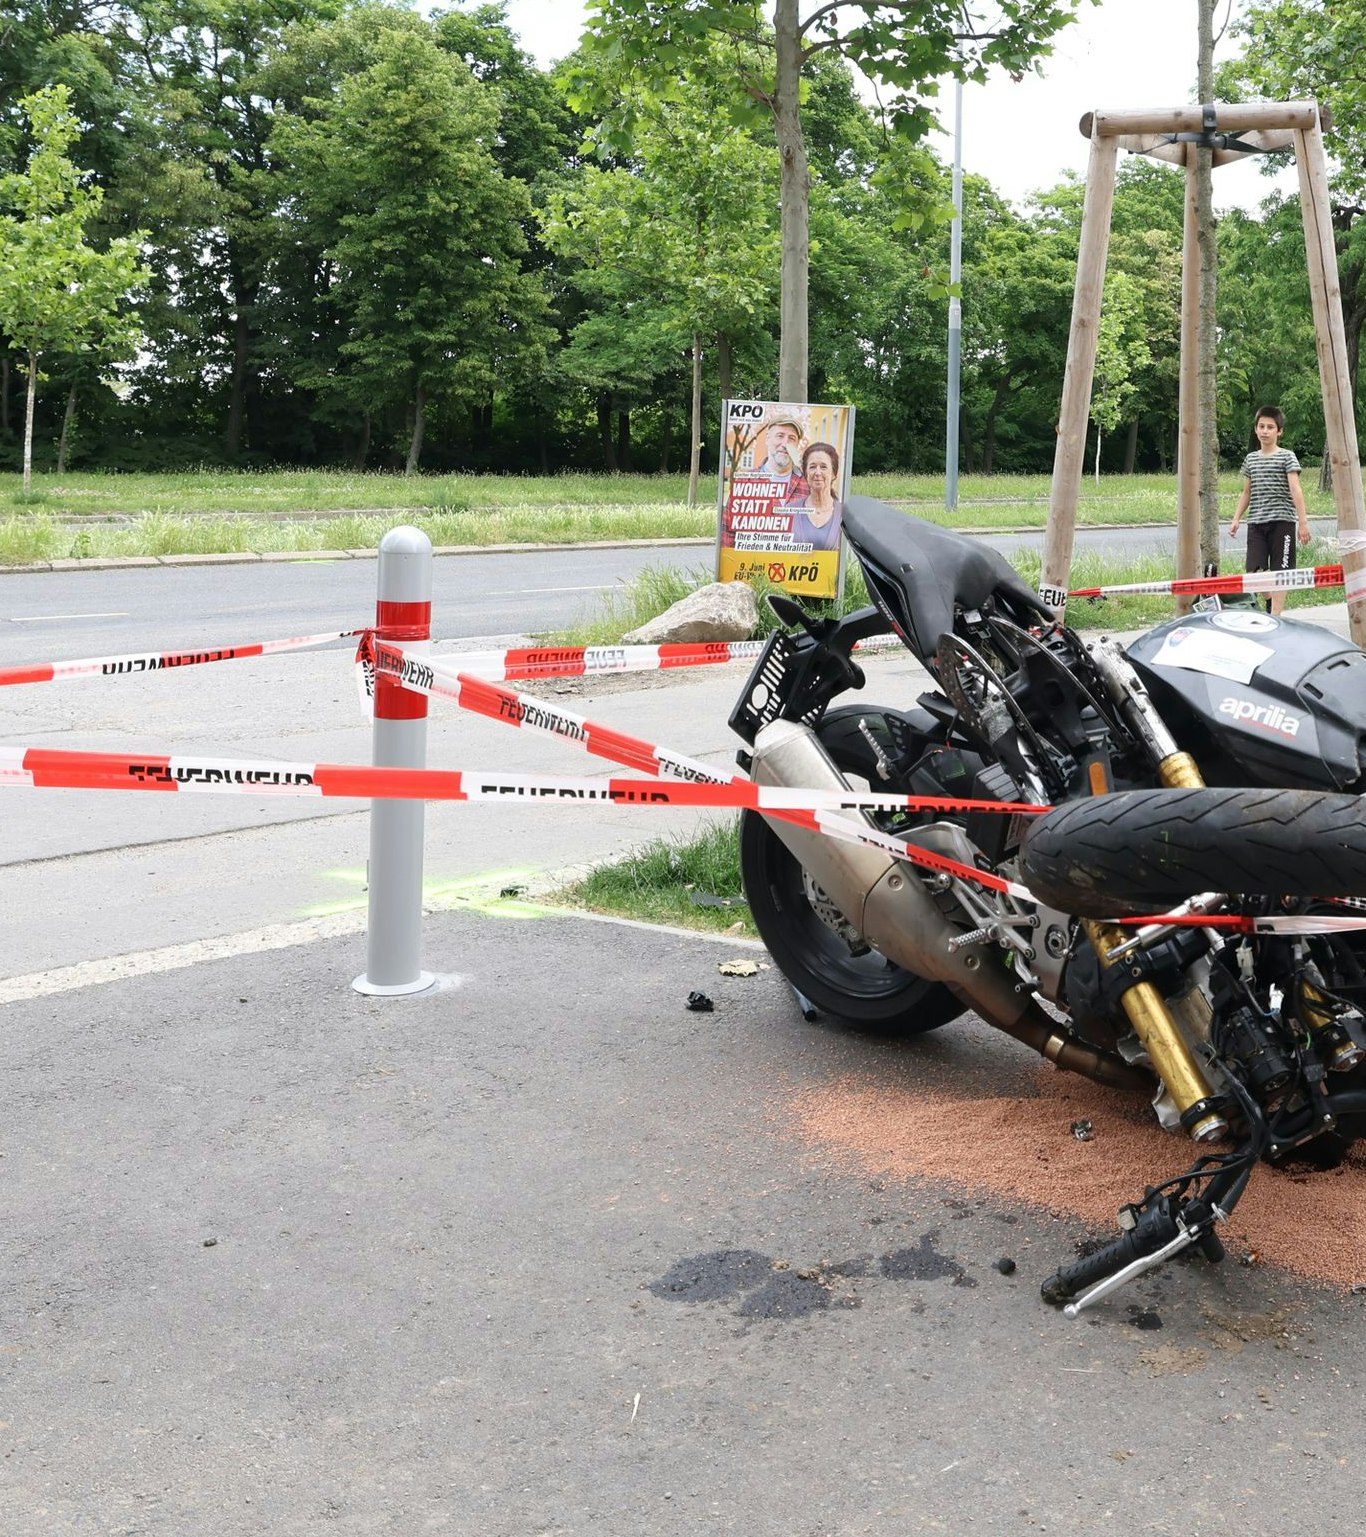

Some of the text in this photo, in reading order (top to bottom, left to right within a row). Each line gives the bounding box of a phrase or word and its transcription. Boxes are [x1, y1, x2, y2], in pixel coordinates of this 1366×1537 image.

[733, 483, 786, 498] WOHNEN
[731, 499, 770, 514] STATT
[731, 515, 791, 531] KANONEN
[737, 532, 792, 542] Ihre Stimme für
[736, 542, 812, 552] Frieden & Neutralität
[739, 562, 766, 572] 9. Juni
[788, 562, 819, 582] KPÖ
[1219, 696, 1300, 736] aprilia
